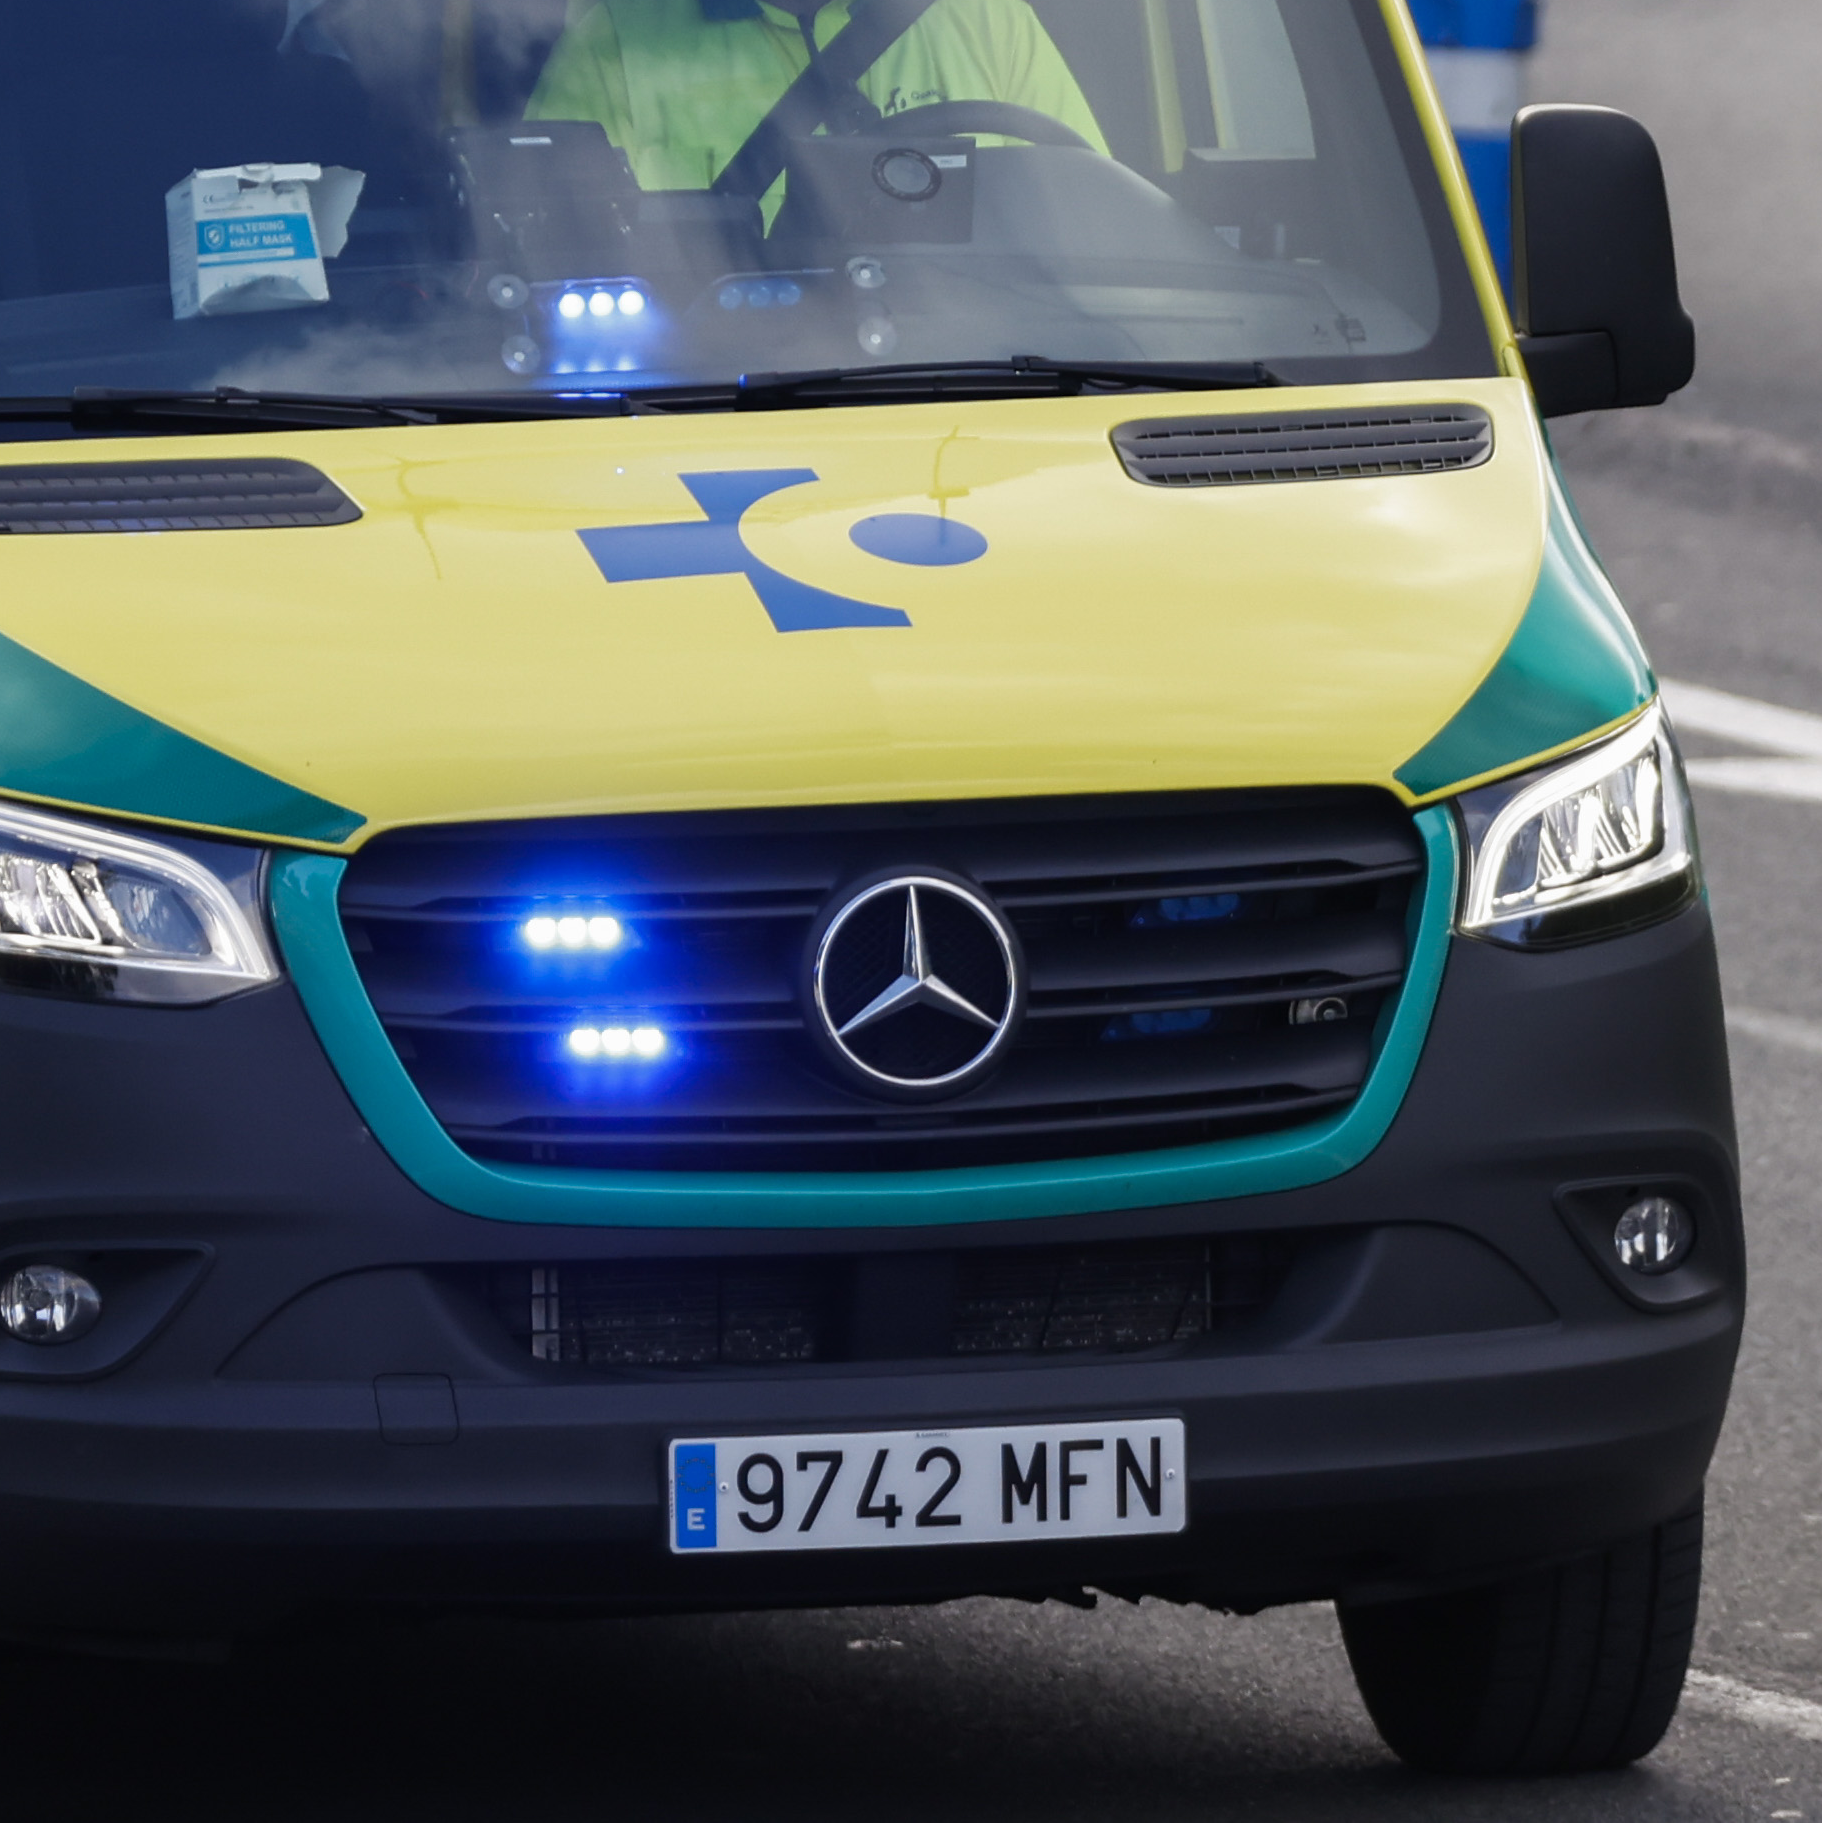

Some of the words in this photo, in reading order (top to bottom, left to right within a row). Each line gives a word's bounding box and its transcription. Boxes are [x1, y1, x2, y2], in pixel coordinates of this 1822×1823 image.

[229, 220, 285, 234] FILTERING
[230, 236, 259, 248] HALF
[262, 233, 293, 246] MASK
[687, 1508, 705, 1530] E
[736, 1445, 962, 1534] 9742
[1001, 1436, 1162, 1523] MFN
